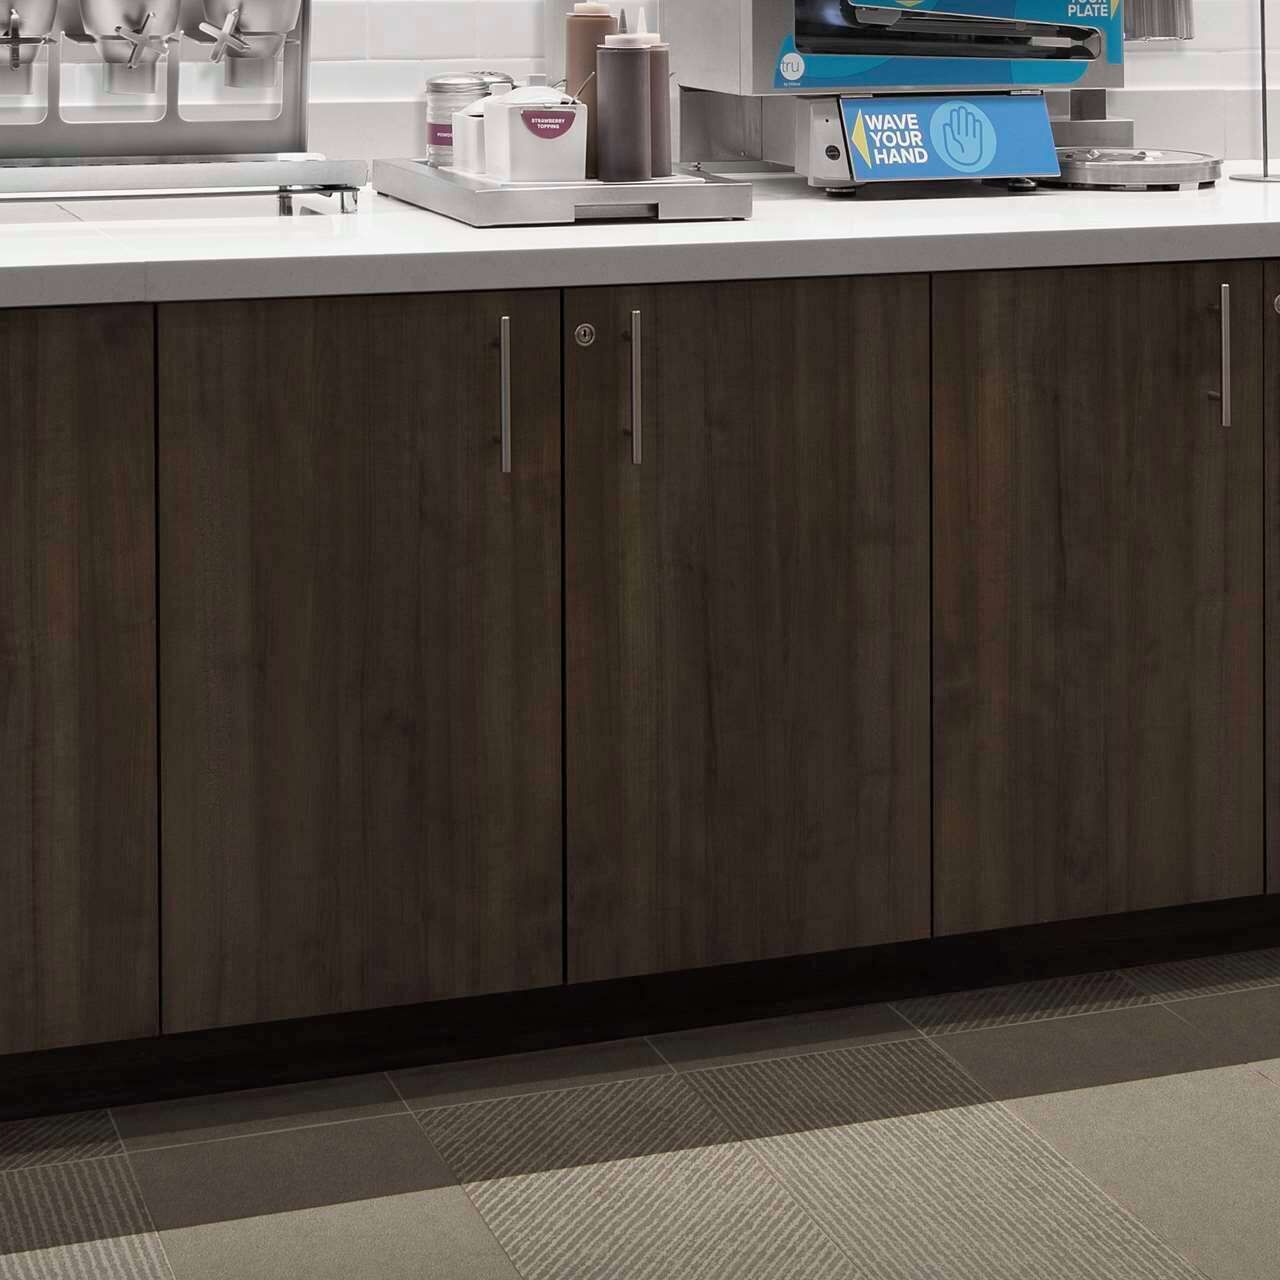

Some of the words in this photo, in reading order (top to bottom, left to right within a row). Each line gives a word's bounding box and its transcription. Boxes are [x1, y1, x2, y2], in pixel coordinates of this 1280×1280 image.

[1068, 4, 1108, 17] PLATE
[781, 60, 800, 73] tru
[864, 113, 919, 130] WAVE
[869, 130, 923, 147] YOUR
[873, 147, 928, 165] HAND
